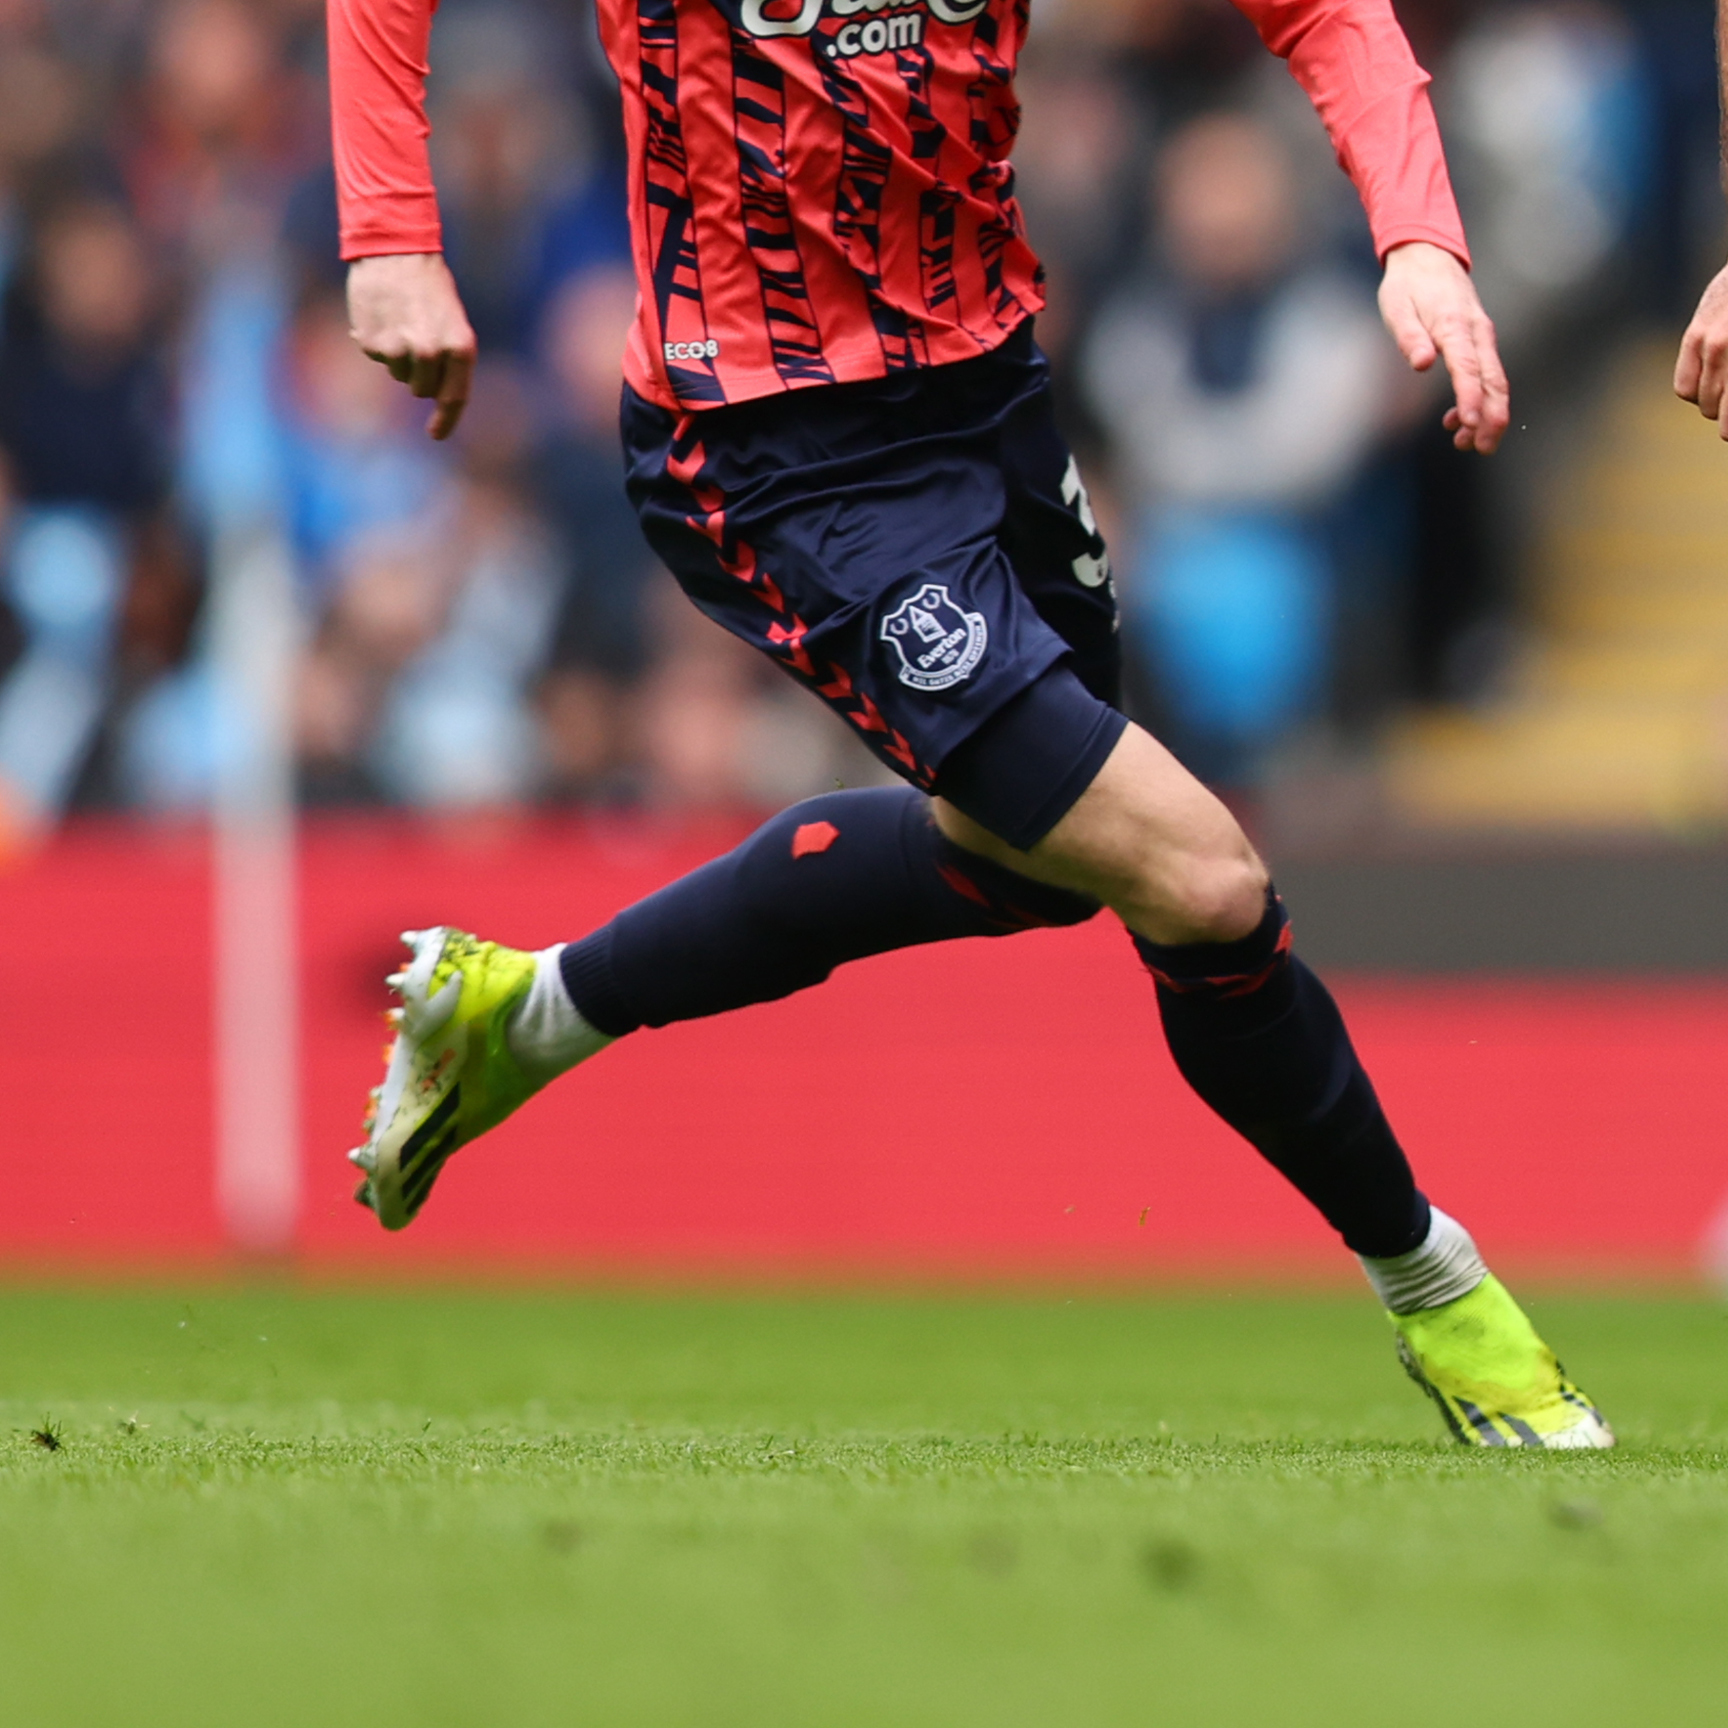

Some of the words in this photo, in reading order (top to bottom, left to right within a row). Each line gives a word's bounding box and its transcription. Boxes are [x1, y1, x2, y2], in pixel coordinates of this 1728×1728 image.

[826, 13, 921, 57] .com
[664, 339, 719, 360] ECO8
[917, 628, 967, 669] Everton
